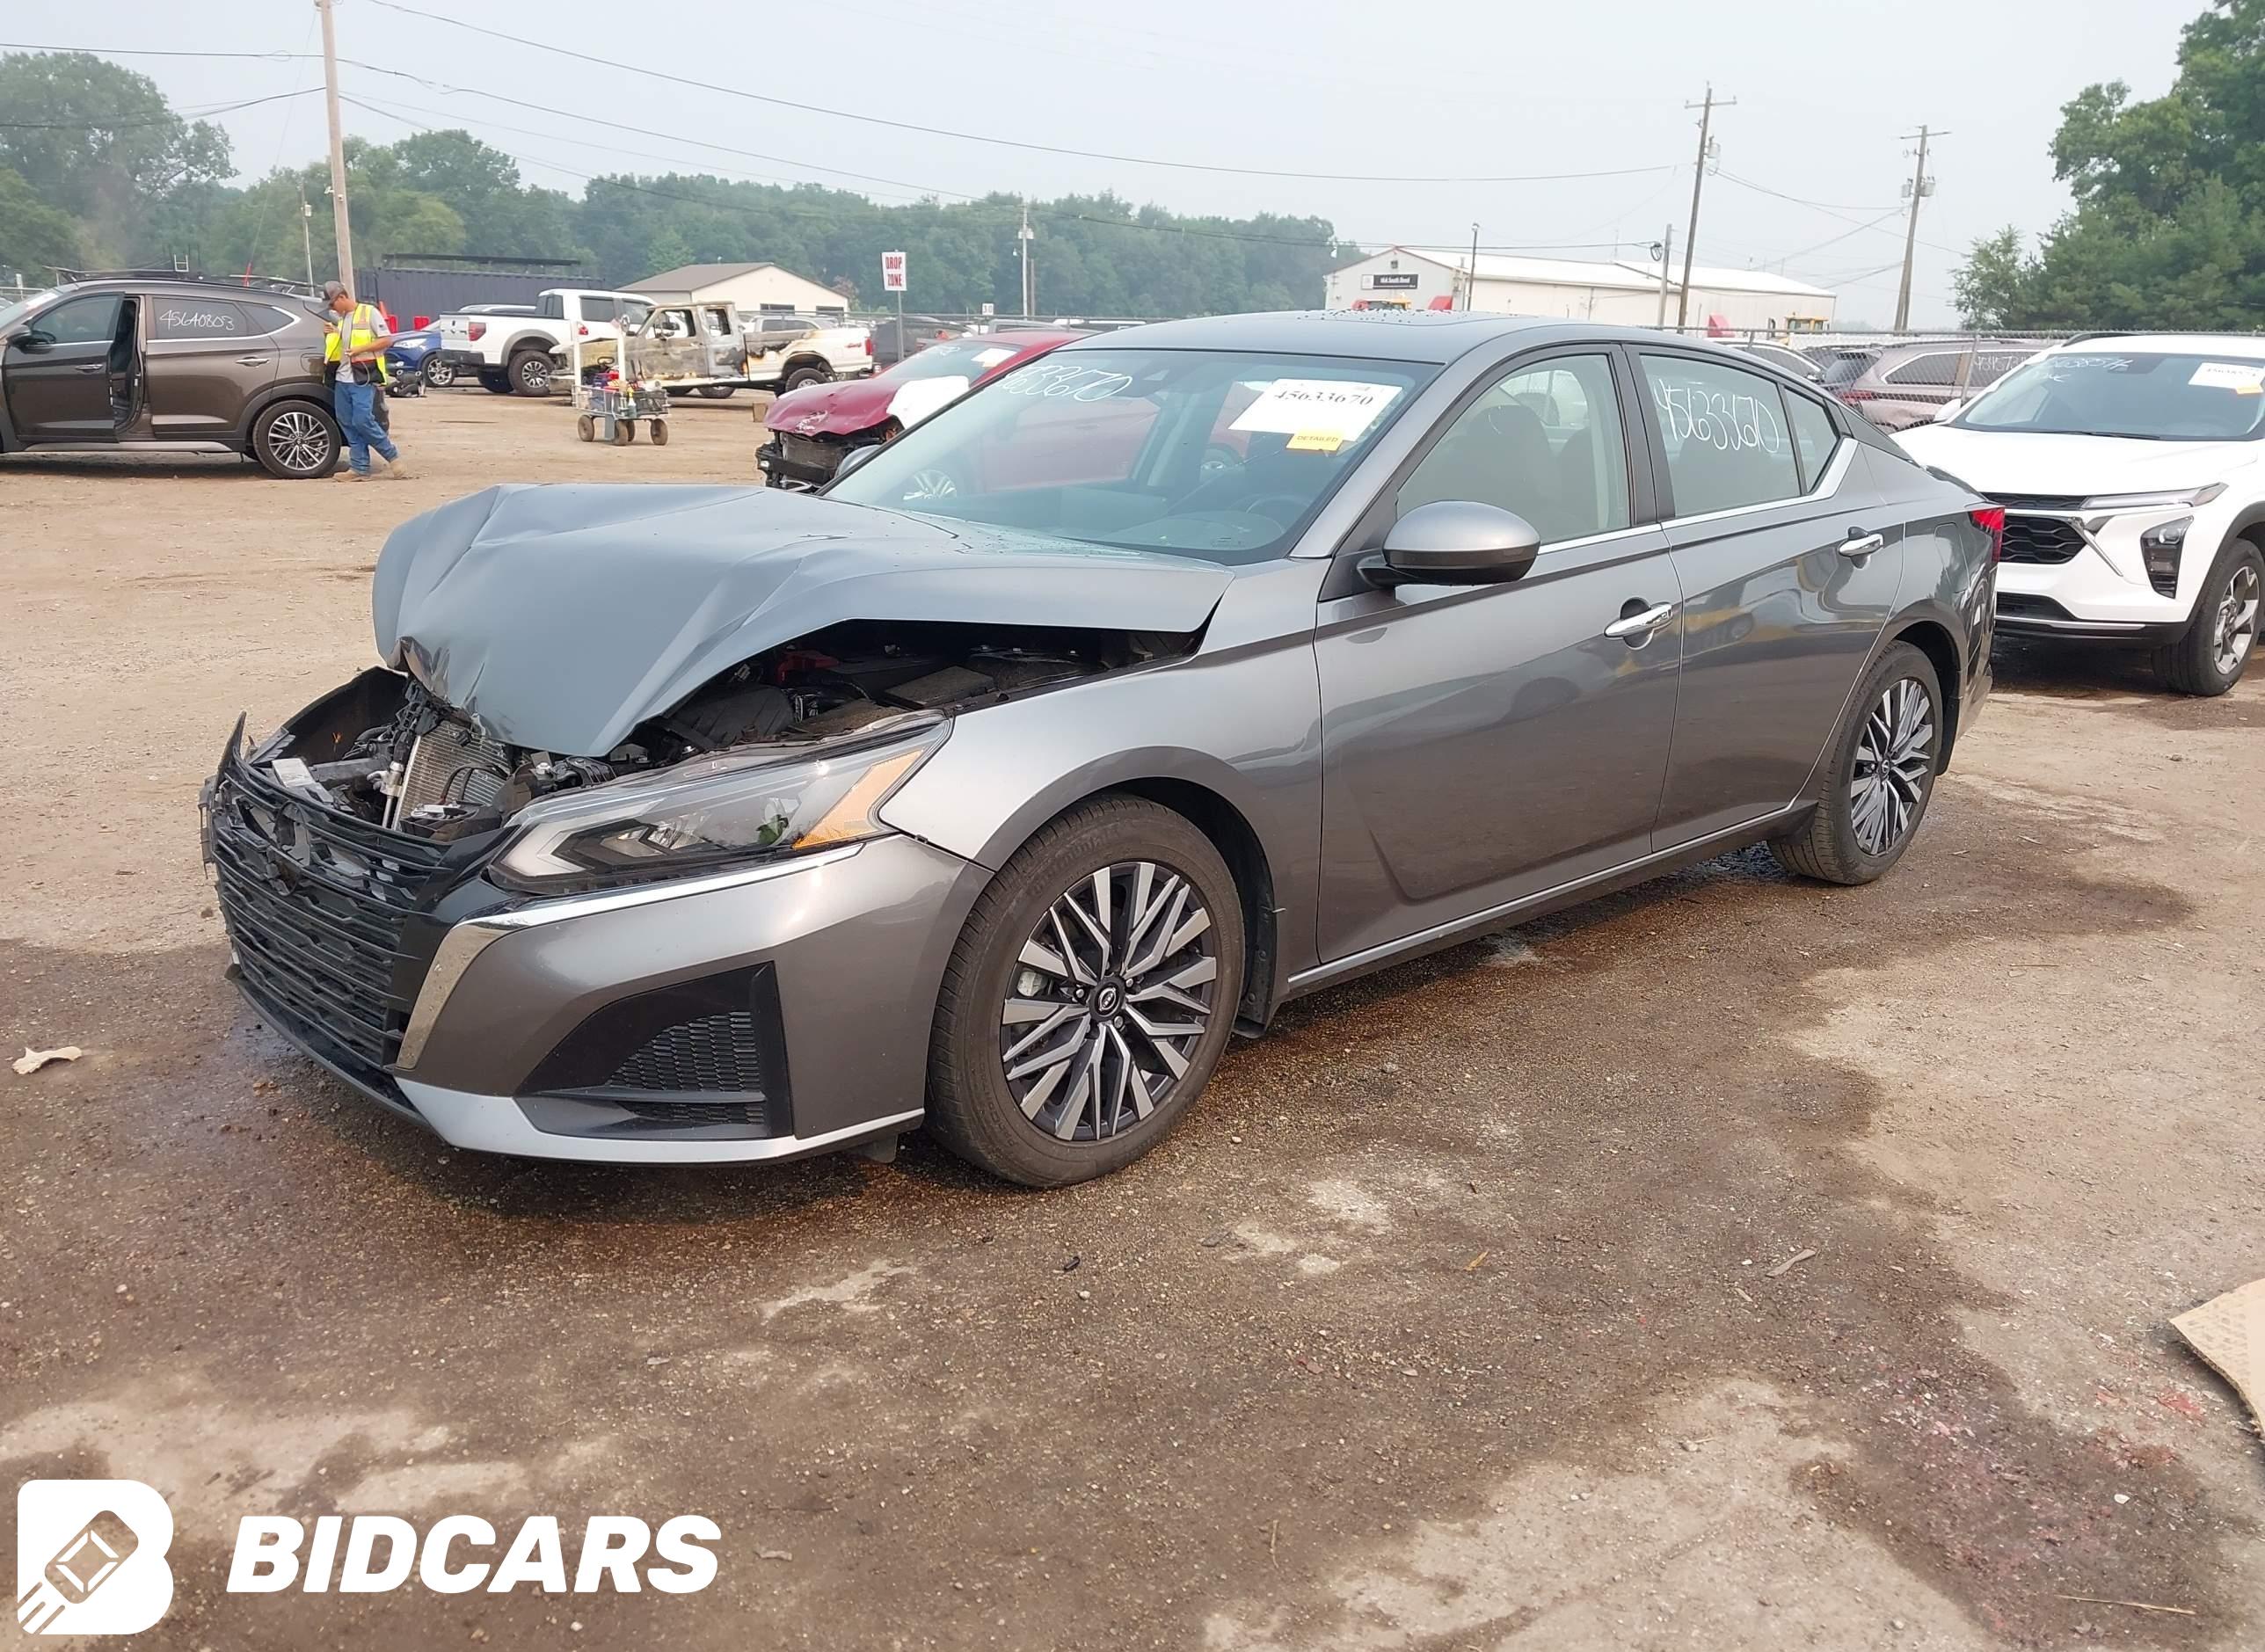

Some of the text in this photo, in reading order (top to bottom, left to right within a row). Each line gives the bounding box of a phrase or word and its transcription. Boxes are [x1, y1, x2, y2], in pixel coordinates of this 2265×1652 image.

[885, 256, 902, 270] DROP
[887, 273, 902, 287] ZONE
[159, 309, 235, 331] 45640803
[1273, 390, 1374, 405] 45633670
